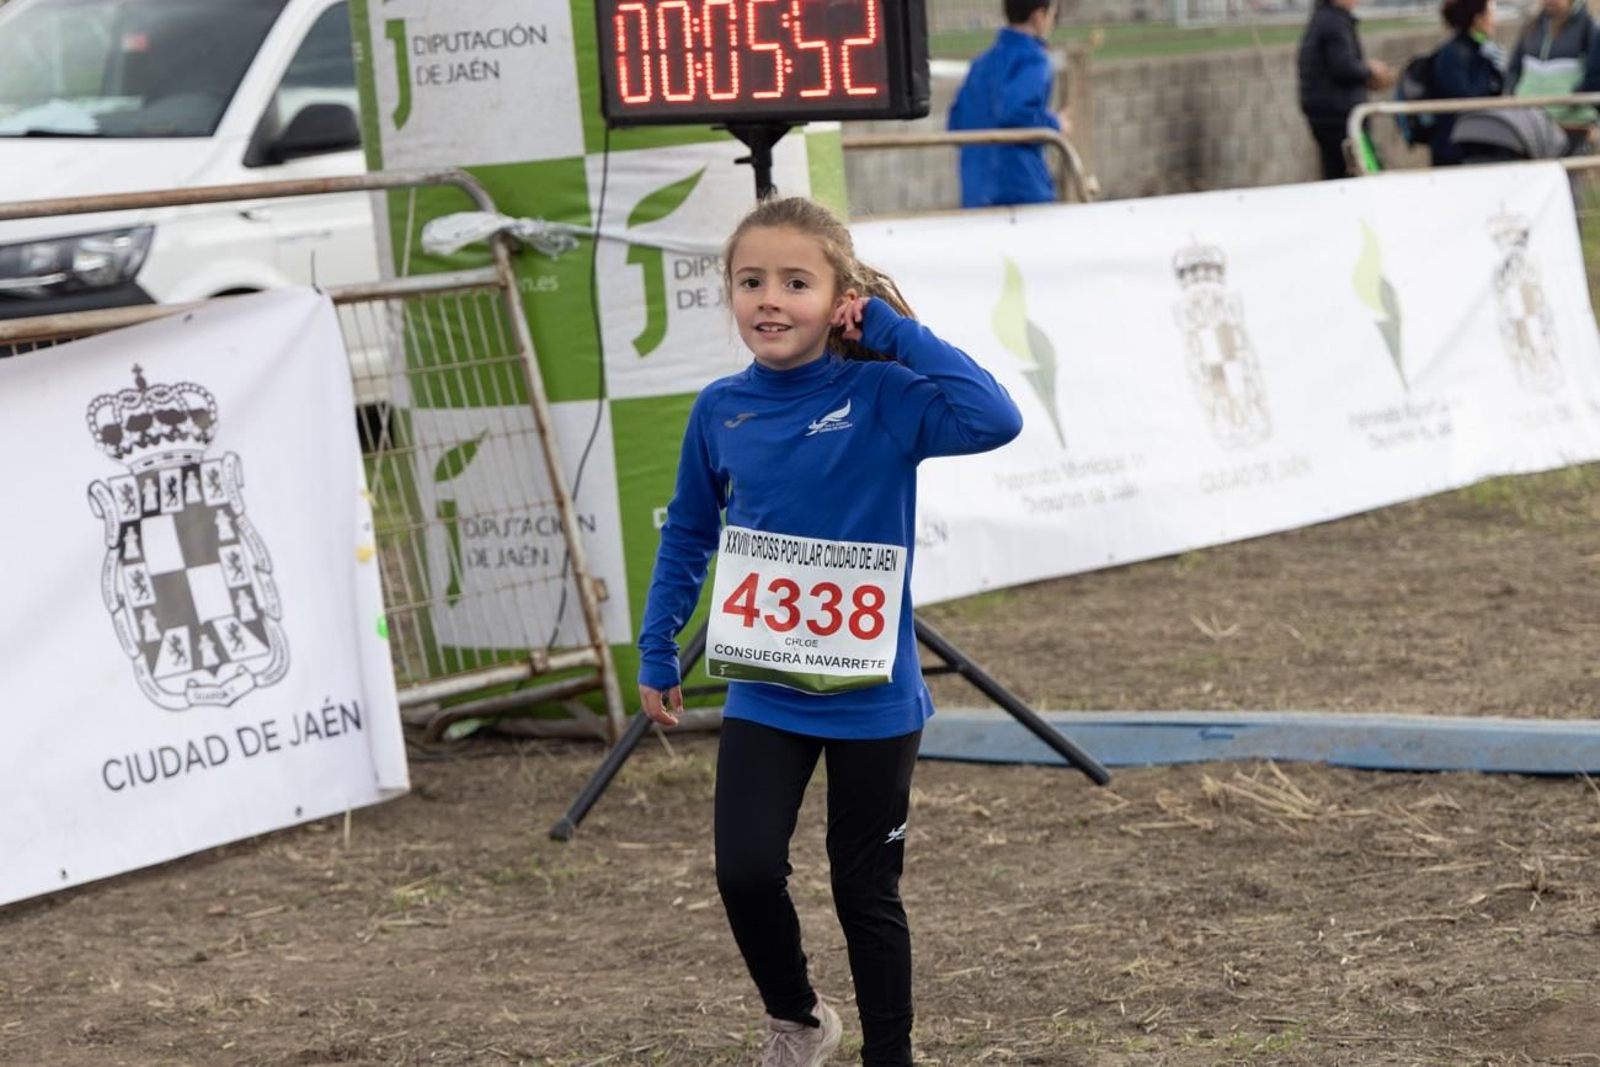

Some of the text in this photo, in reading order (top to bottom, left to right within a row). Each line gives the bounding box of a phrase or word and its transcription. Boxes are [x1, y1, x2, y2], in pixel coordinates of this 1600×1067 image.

[413, 22, 547, 56] DIPUTACIÓN
[416, 58, 500, 86] DE JAÉN
[677, 287, 709, 310] DE
[751, 534, 780, 561] CROSS
[780, 539, 822, 567] POPULAR
[824, 544, 858, 569] CIUDAD
[859, 547, 873, 569] DE
[722, 572, 886, 640] 4338
[714, 643, 886, 669] CONSUEGRA NAVARRETE
[785, 637, 819, 648] CHLOE
[102, 697, 362, 791] CIUDAD DE JAÉN
